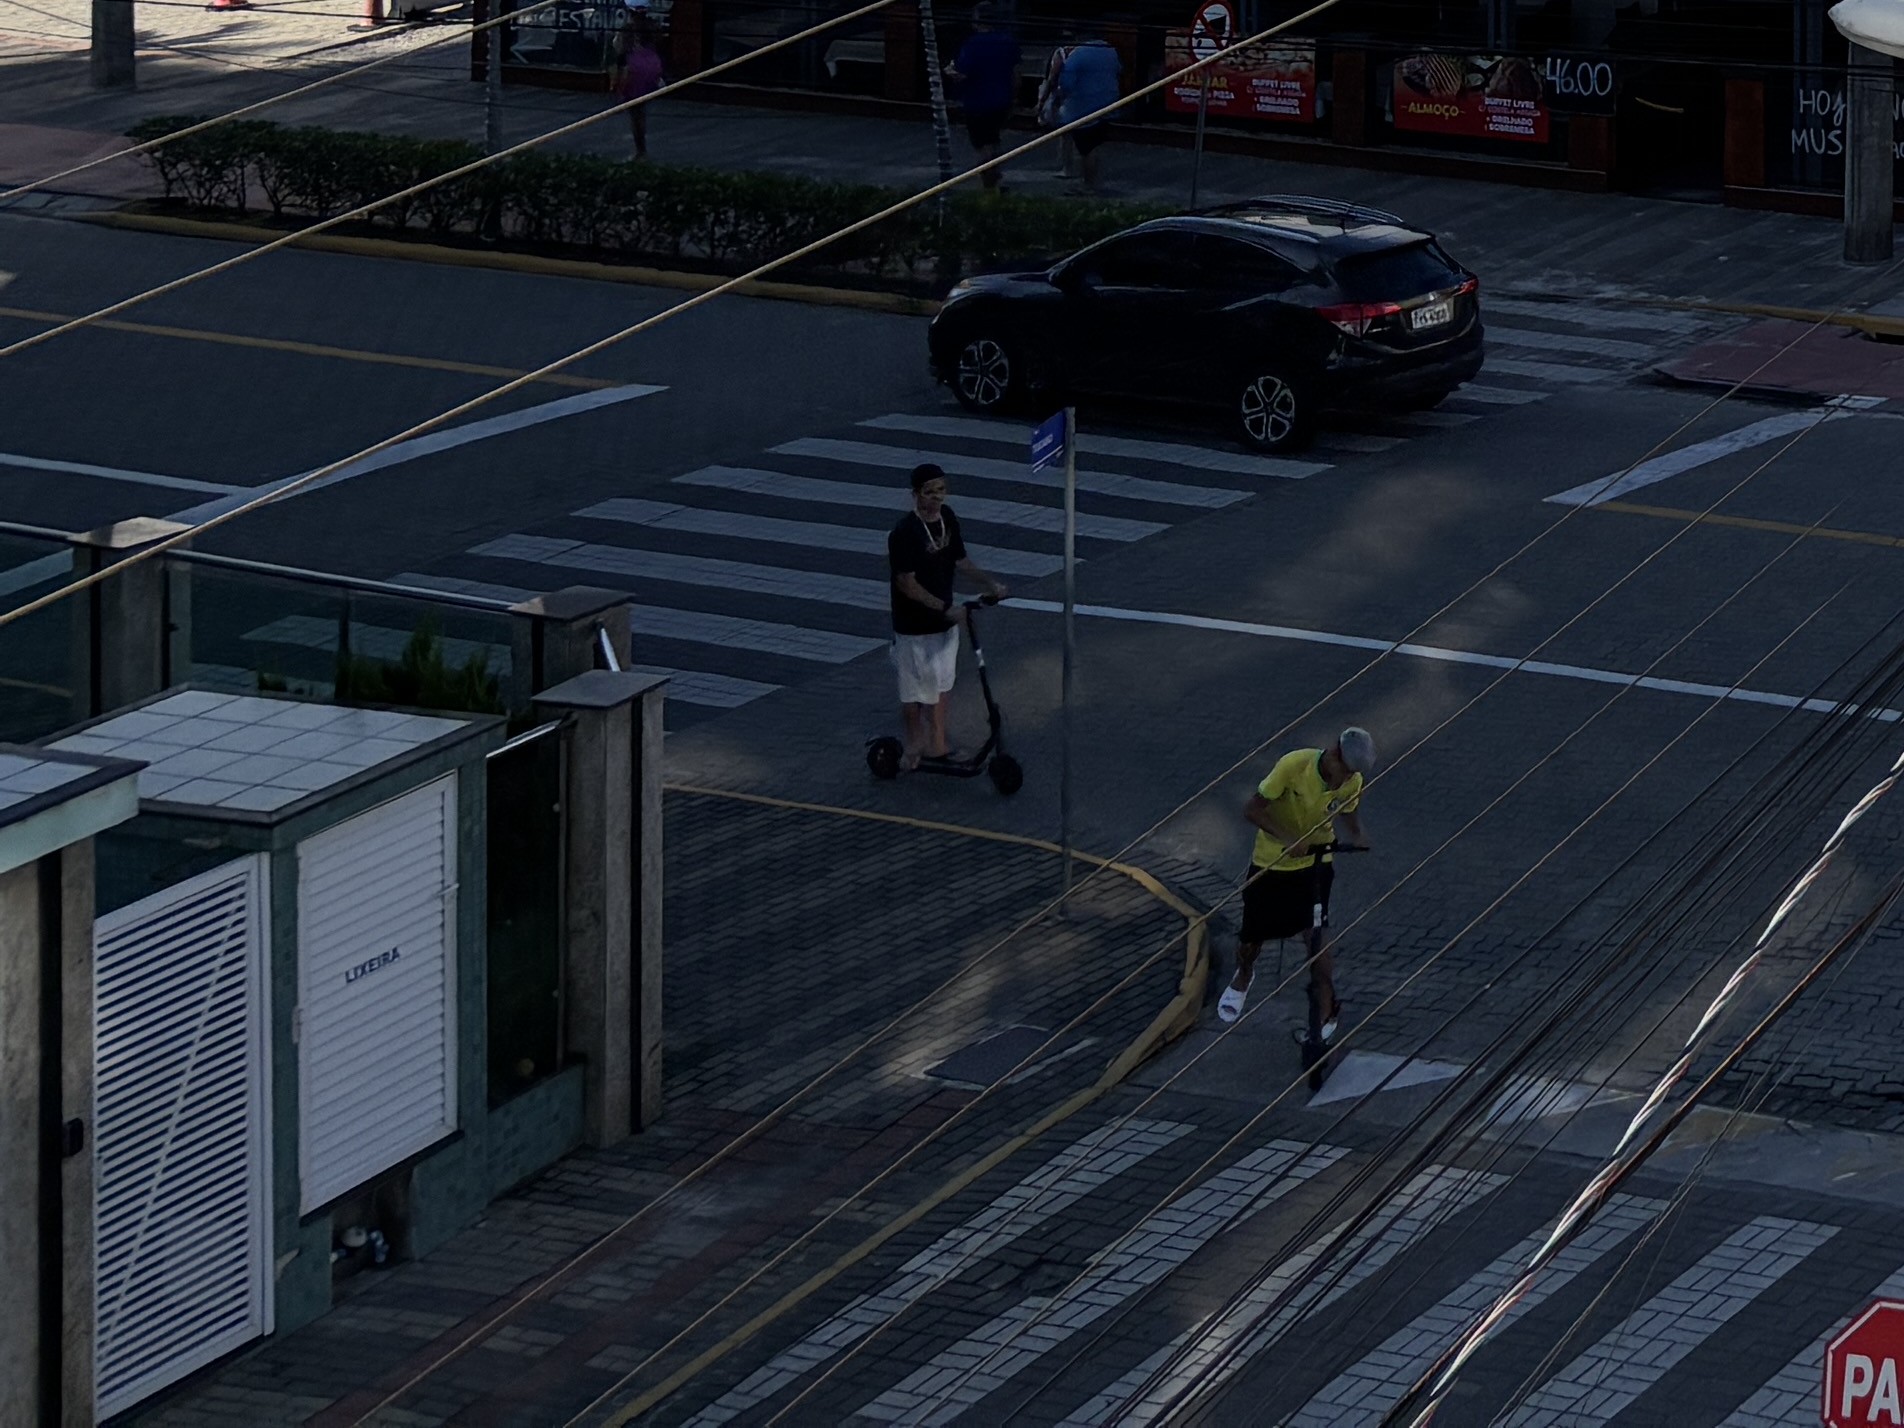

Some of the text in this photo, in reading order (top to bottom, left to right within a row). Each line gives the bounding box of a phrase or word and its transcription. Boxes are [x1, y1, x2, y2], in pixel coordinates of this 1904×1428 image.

[1546, 58, 1612, 96] 46.00
[1408, 103, 1459, 120] ALMOÇO
[1799, 89, 1847, 127] HOJ
[1791, 128, 1844, 155] MUS
[346, 947, 401, 984] LIXEIRA
